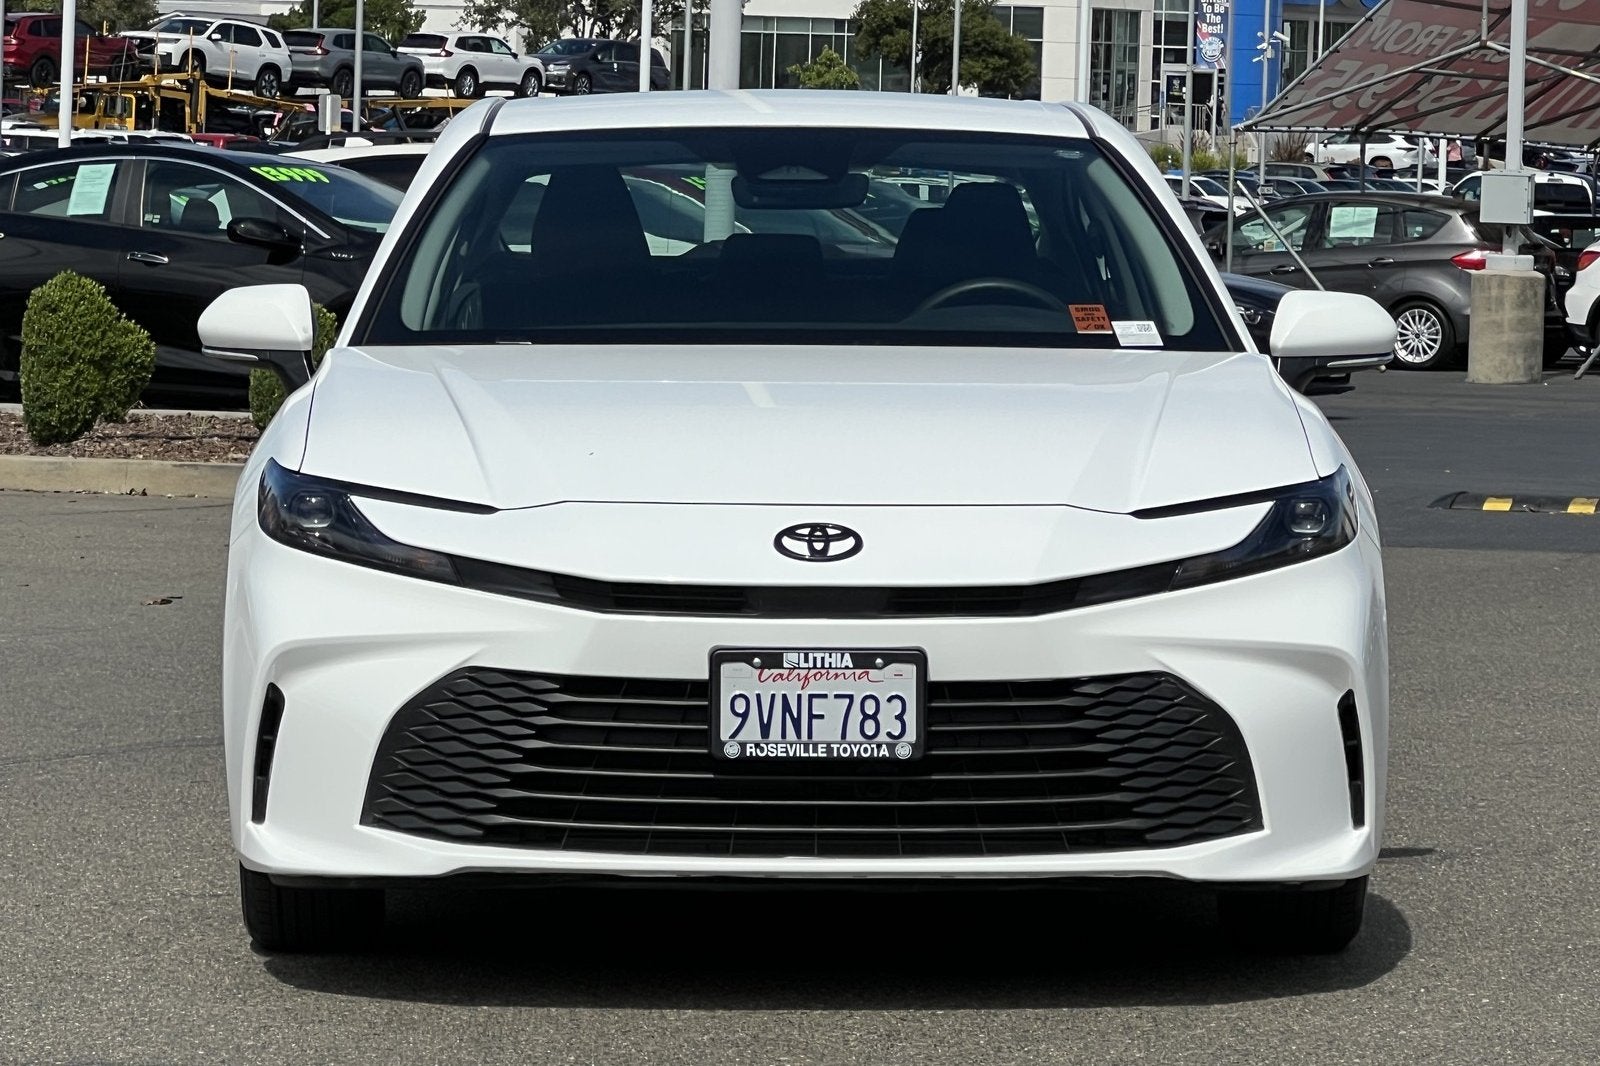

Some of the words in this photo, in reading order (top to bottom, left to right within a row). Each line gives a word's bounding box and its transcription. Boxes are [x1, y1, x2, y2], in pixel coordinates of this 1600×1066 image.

[1202, 3, 1212, 13] To
[1214, 3, 1225, 13] Be
[1205, 13, 1222, 24] The
[1202, 23, 1224, 34] Best!
[249, 167, 330, 183] 13999
[799, 653, 854, 669] LITHIA
[757, 668, 884, 690] California
[728, 693, 907, 740] 9VNF783
[746, 743, 827, 758] ROSEVILLE
[830, 743, 890, 758] TOYOTA
